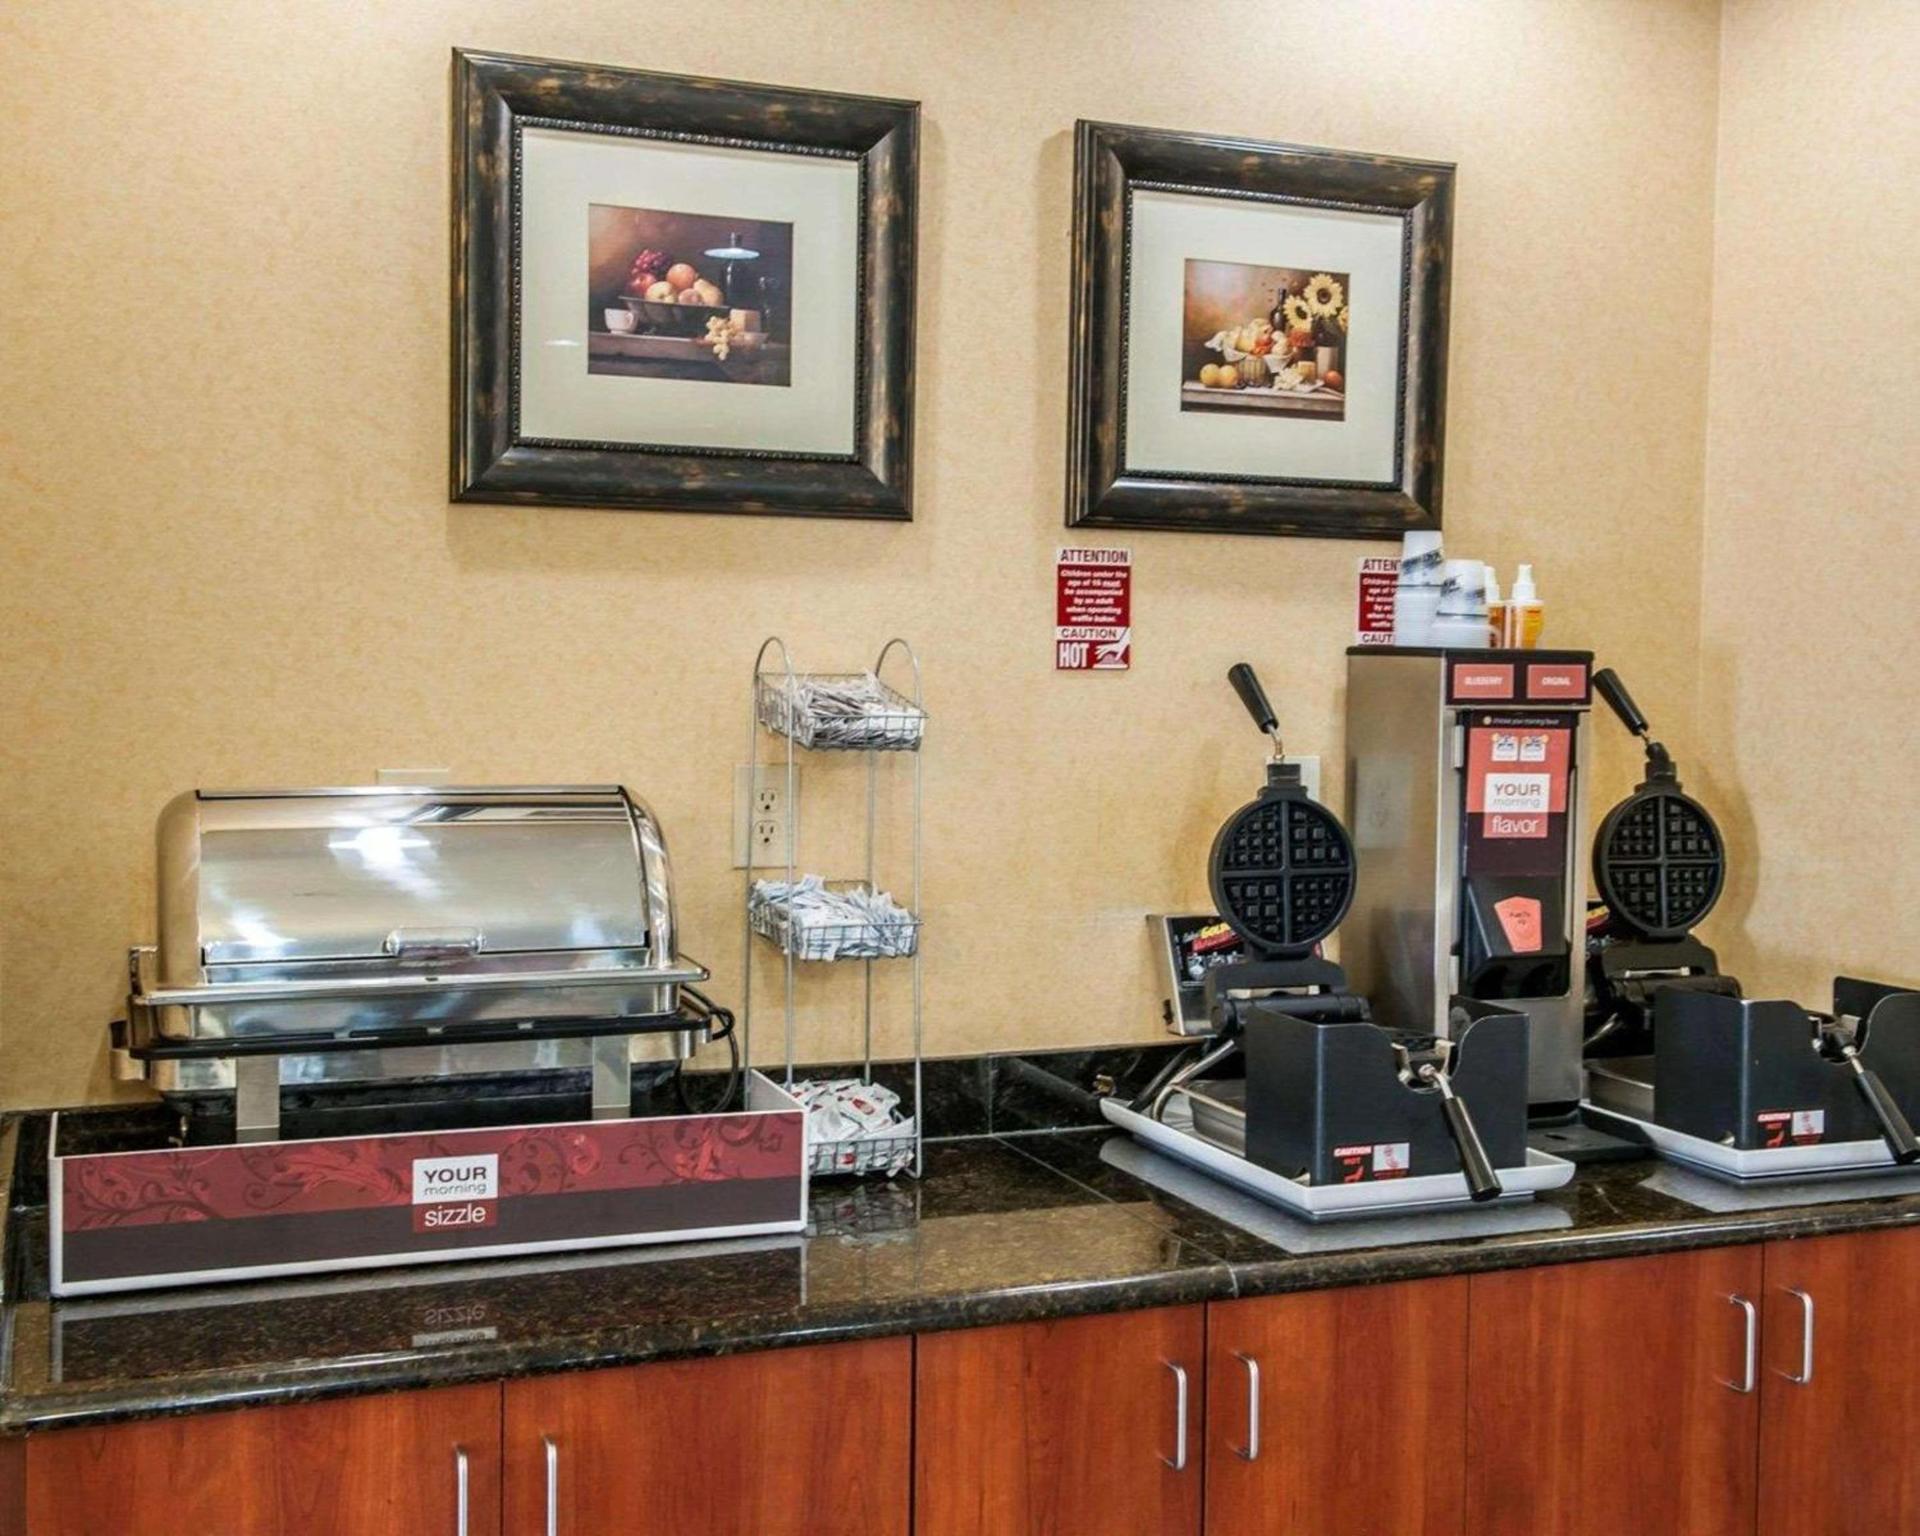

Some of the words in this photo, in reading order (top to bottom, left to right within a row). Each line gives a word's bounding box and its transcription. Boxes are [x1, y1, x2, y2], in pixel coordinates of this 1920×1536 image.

[1060, 549, 1129, 563] ATTENTION
[1362, 558, 1400, 572] ATTEN
[1061, 628, 1117, 639] CAUTION
[1362, 633, 1392, 643] CAUT
[1059, 642, 1090, 668] HOT
[1494, 783, 1541, 797] YOUR
[1493, 797, 1541, 809] morning
[1491, 816, 1539, 834] flavor
[424, 1166, 488, 1184] YOUR
[424, 1182, 488, 1197] morning
[424, 1203, 487, 1228] sizzle
